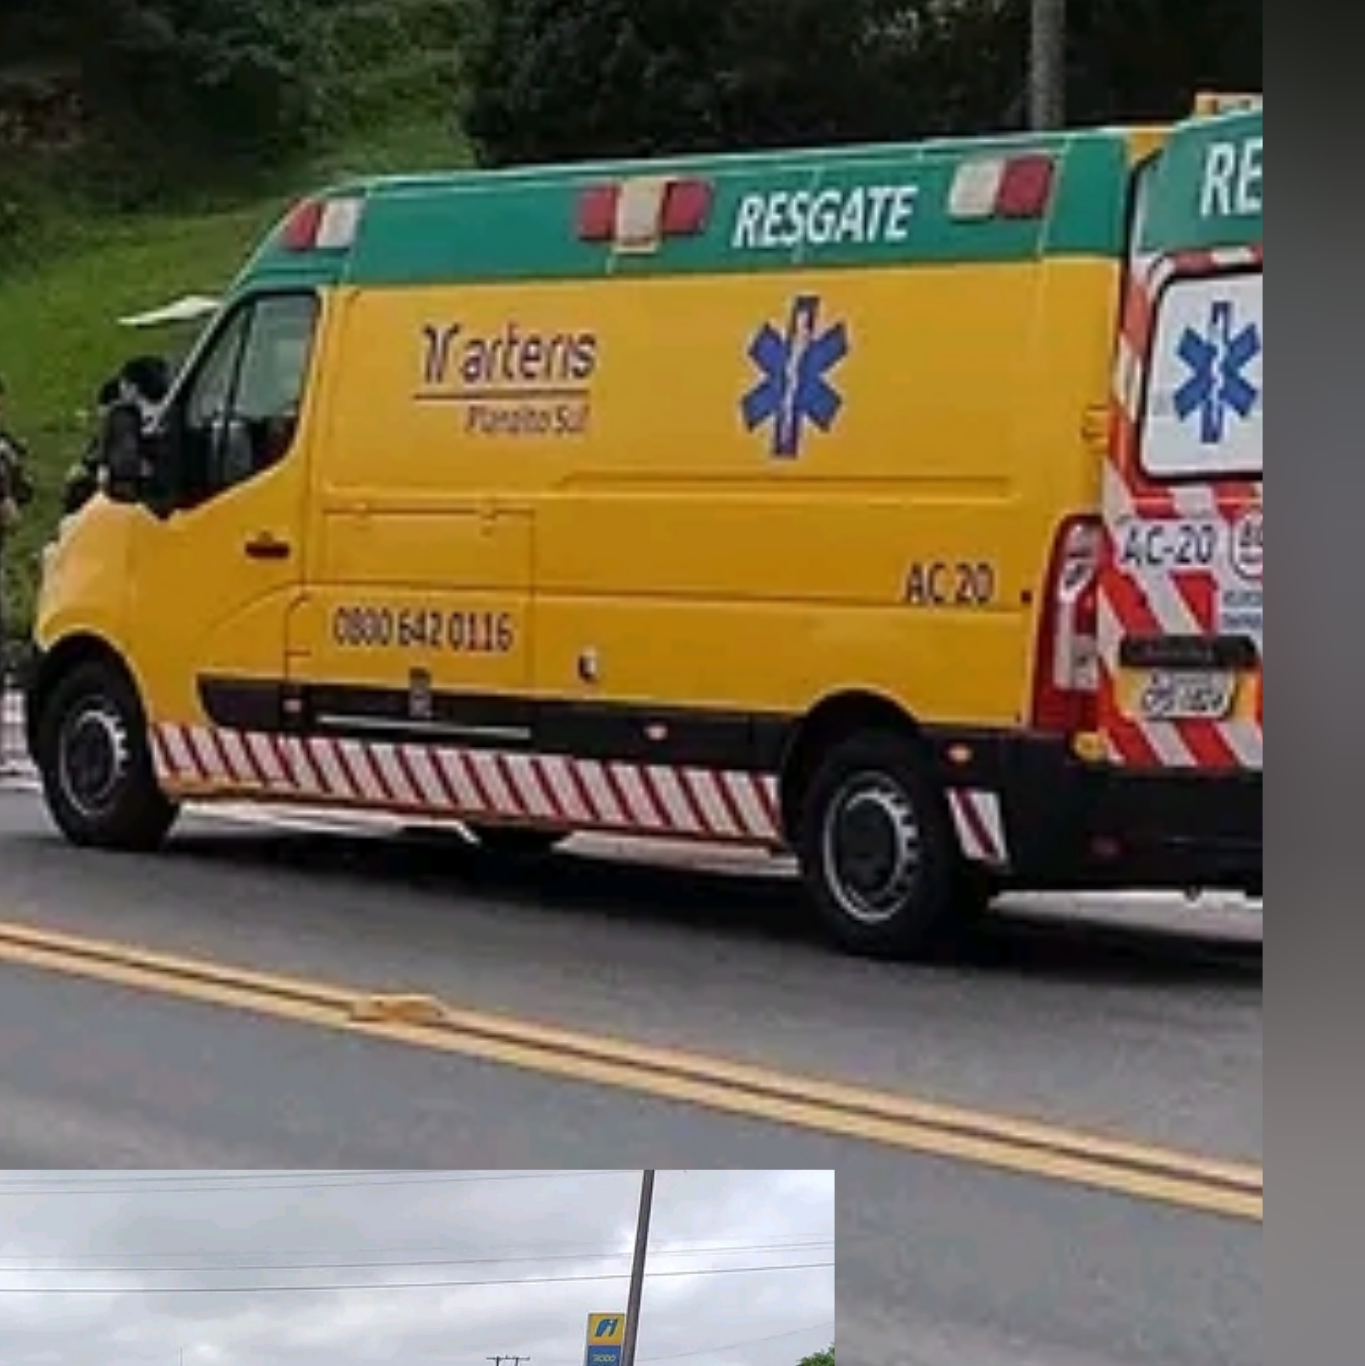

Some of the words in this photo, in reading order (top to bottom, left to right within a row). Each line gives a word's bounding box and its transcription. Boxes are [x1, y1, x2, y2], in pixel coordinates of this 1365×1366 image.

[732, 185, 919, 249] RESGATE
[1121, 524, 1214, 566] AC-20
[903, 561, 945, 603] AC
[955, 561, 994, 604] 20
[333, 606, 393, 647] 0800
[398, 609, 442, 649] 642
[449, 611, 514, 652] 0116
